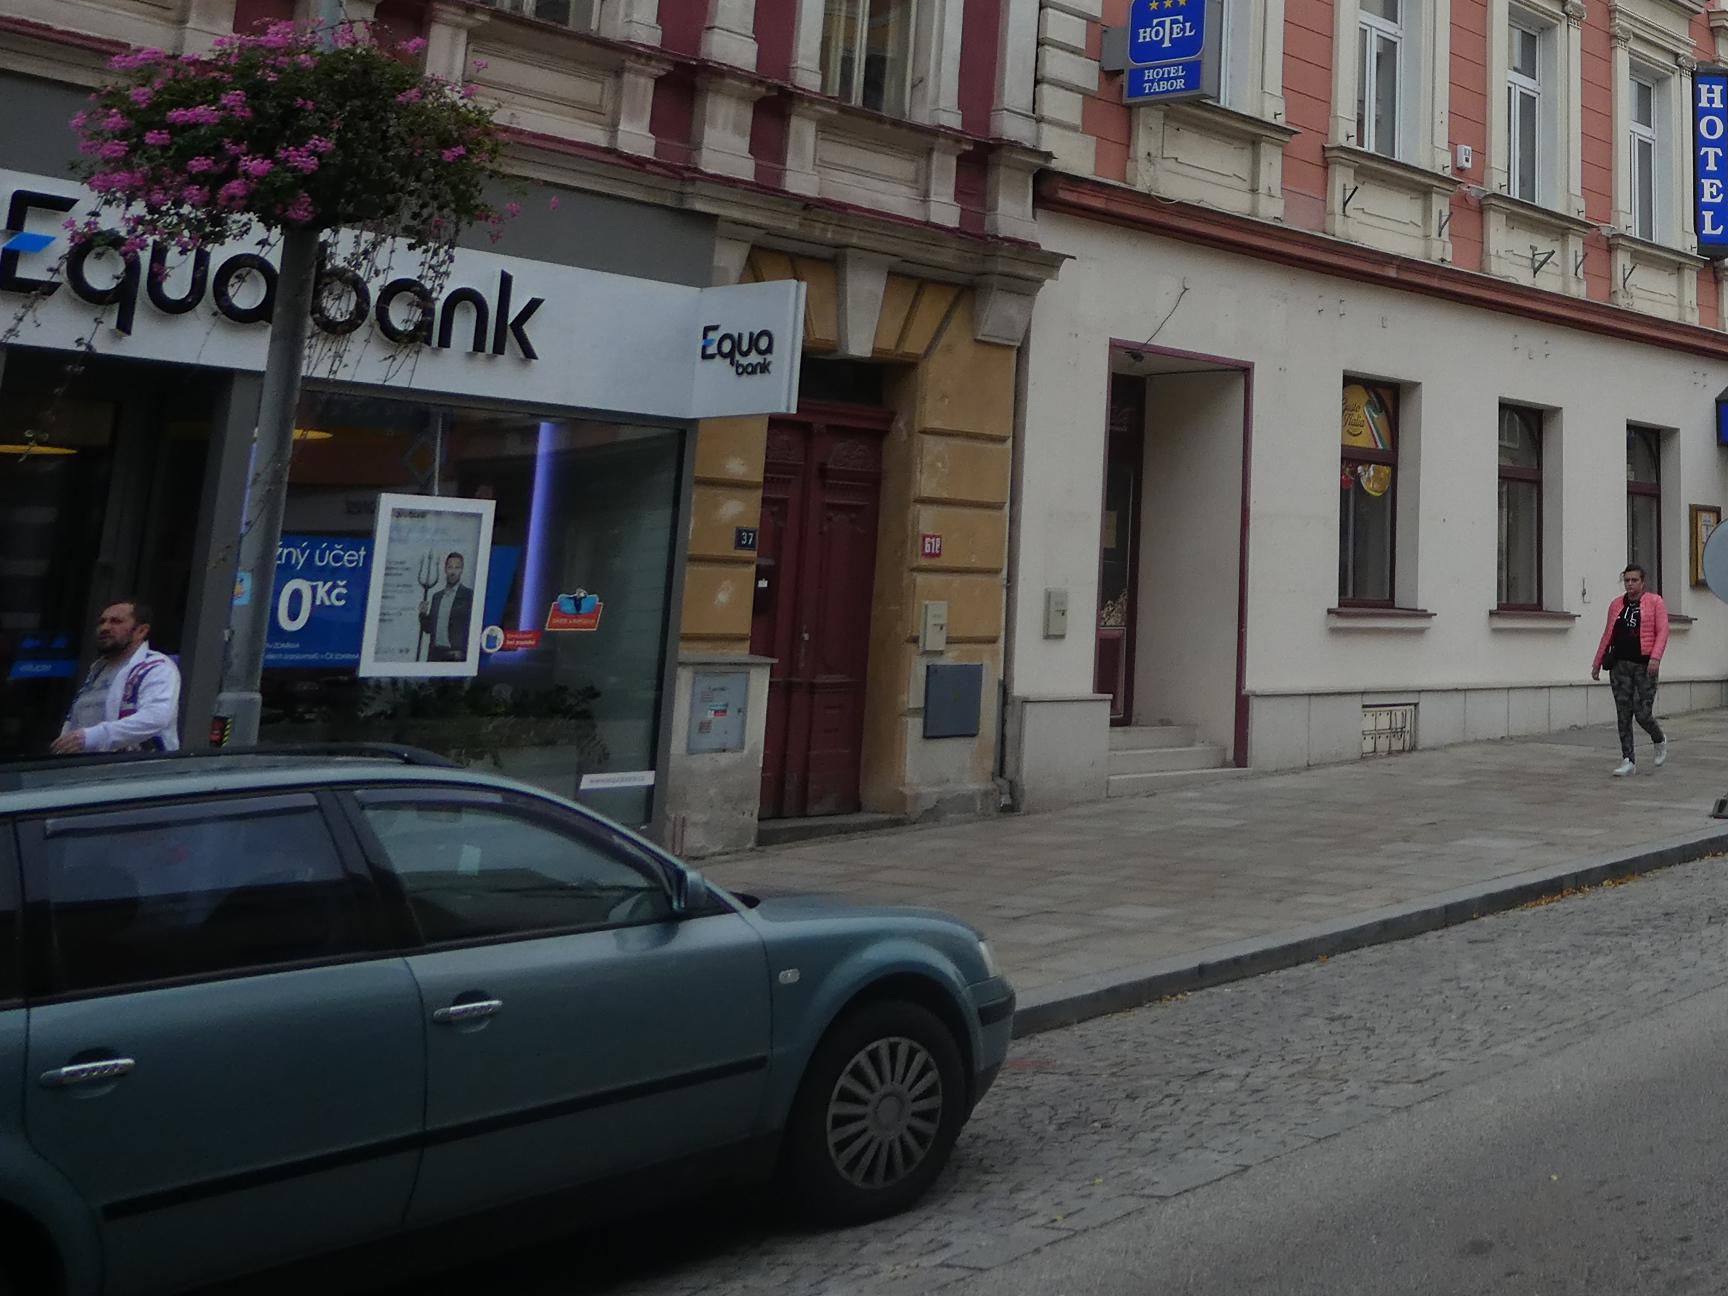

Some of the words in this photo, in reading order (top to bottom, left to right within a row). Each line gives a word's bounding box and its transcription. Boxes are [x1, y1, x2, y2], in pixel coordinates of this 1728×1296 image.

[1137, 15, 1196, 48] HOTEL
[1143, 65, 1186, 81] HOTEL
[1143, 79, 1186, 93] TÁBOR
[1698, 84, 1724, 235] HOTEL
[0, 189, 280, 336] Equa
[311, 241, 545, 360] bank
[701, 324, 774, 367] Equa
[735, 357, 772, 376] bank
[741, 532, 754, 545] 37
[275, 542, 311, 568] žný
[314, 543, 366, 568] účet
[277, 578, 313, 631] 0
[314, 580, 348, 607] Kč
